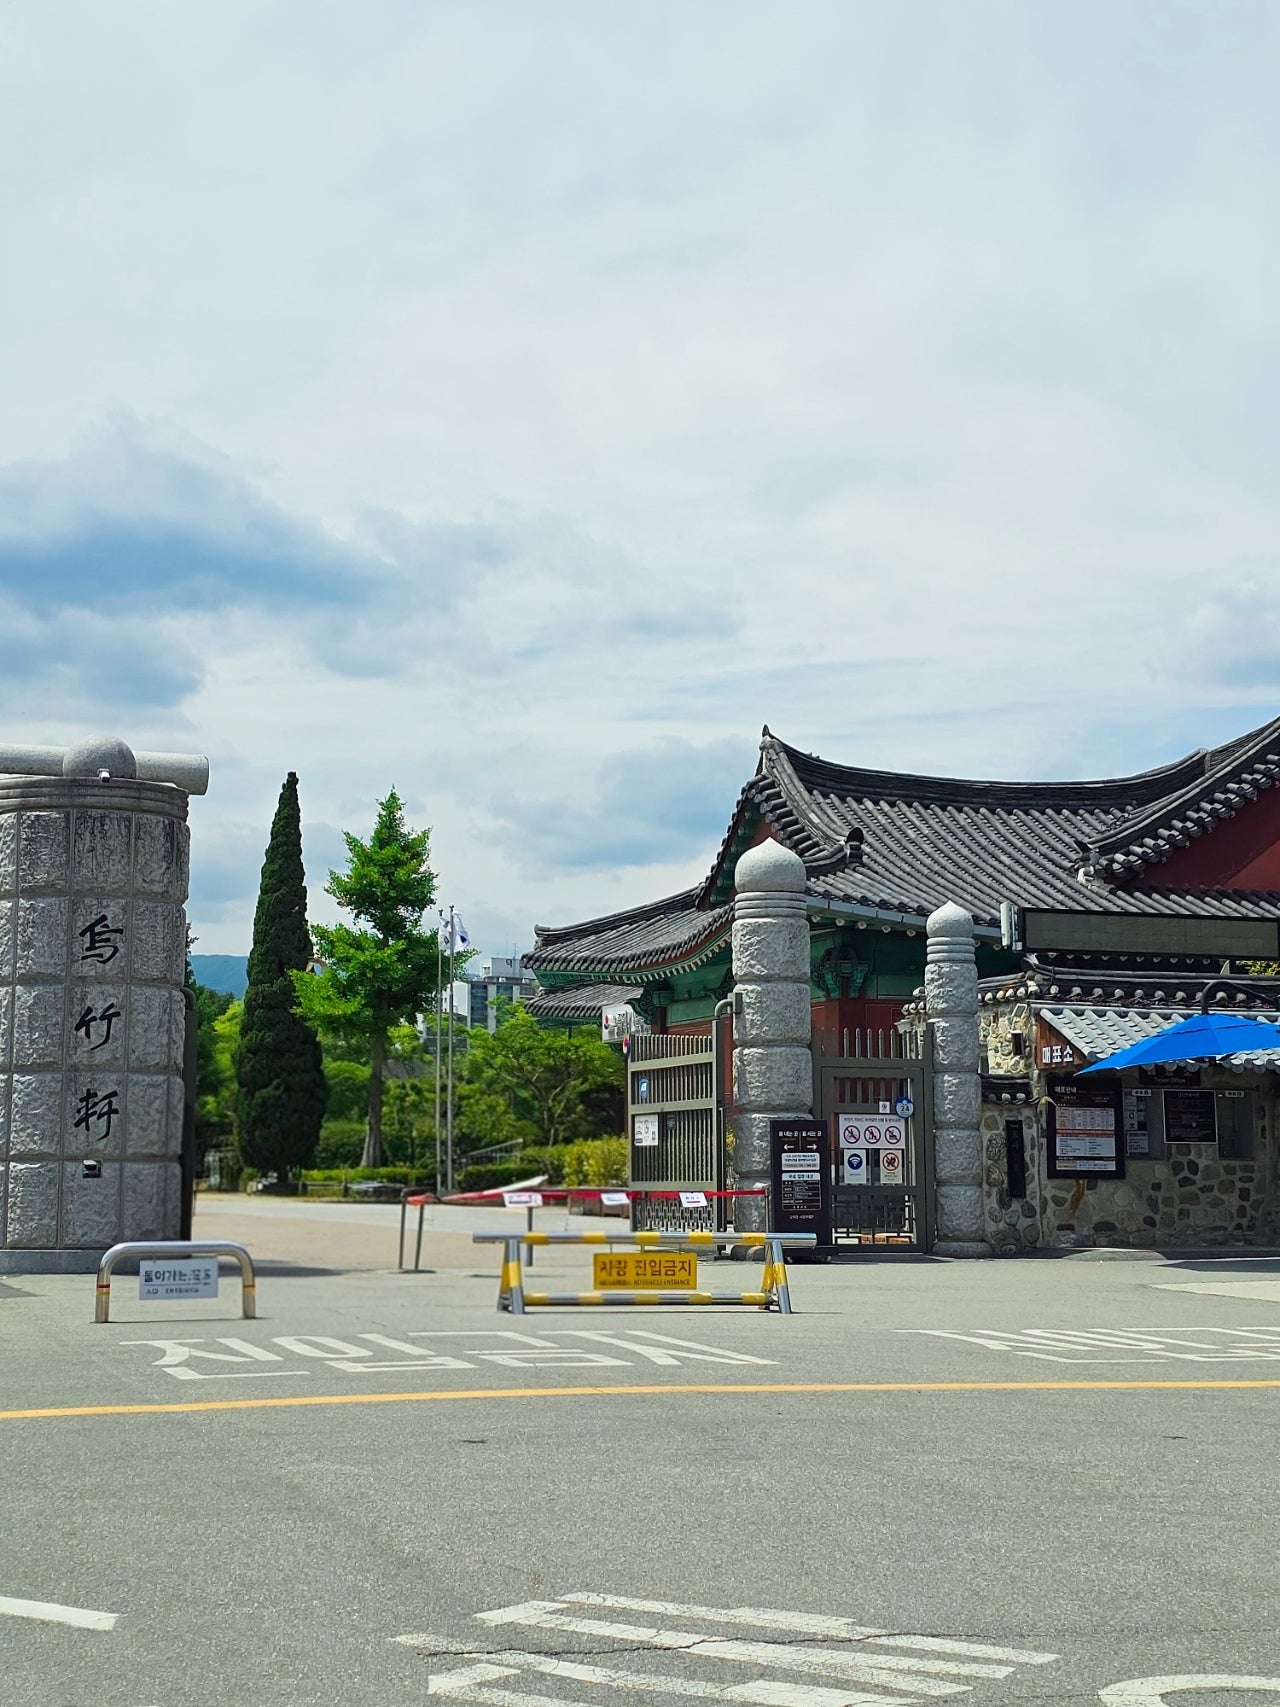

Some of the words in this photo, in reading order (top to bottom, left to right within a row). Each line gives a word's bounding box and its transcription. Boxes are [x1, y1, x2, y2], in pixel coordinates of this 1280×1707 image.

[1042, 1044, 1073, 1064] 매표소
[634, 1259, 692, 1277] 진입금지
[119, 1329, 781, 1381] 진입금지
